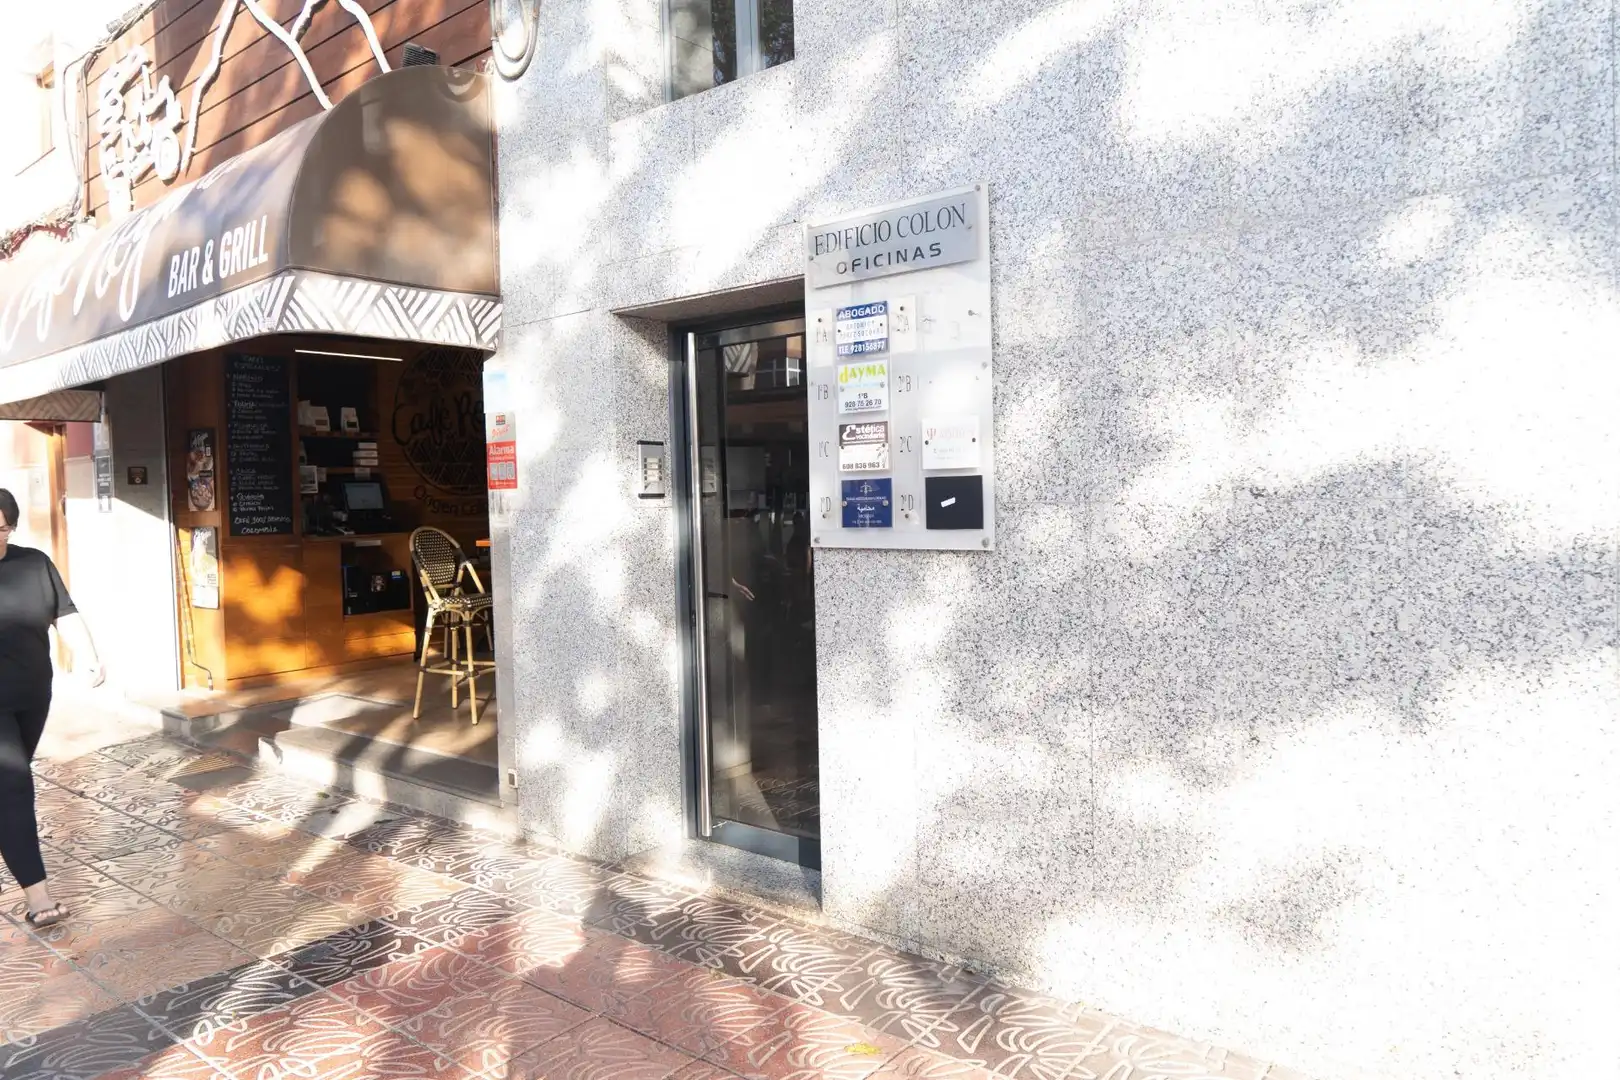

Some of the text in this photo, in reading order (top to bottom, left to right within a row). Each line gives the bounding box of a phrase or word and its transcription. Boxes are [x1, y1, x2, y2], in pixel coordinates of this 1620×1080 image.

[815, 203, 966, 256] EDIFICIO COLON
[167, 215, 269, 298] BAR & GRILL
[836, 242, 942, 274] OFICINAS
[838, 303, 885, 320] ABOGADO
[489, 443, 514, 454] Alarma
